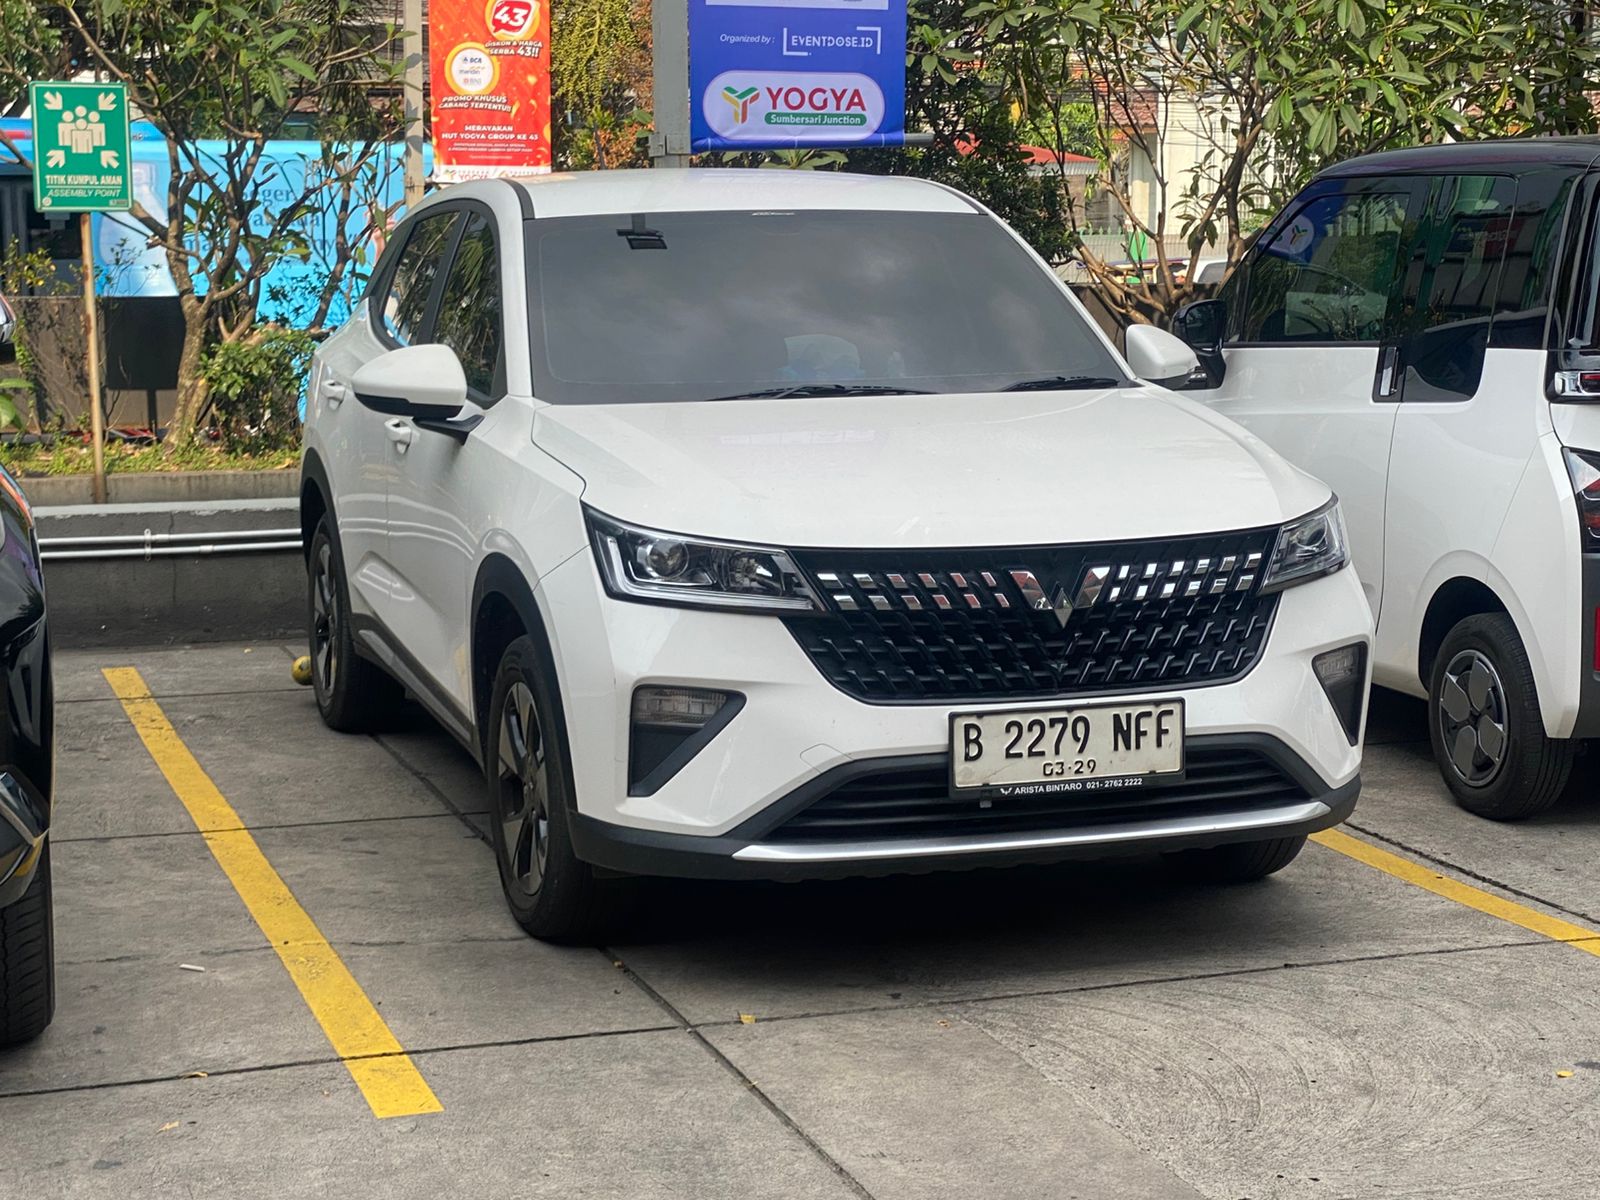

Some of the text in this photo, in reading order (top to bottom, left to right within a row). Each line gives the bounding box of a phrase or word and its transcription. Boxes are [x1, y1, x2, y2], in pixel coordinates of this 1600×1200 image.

[494, 6, 529, 27] 43
[485, 40, 511, 48] DISKON
[519, 40, 543, 48] HARGA
[720, 33, 760, 44] Organized
[791, 35, 873, 48] EVENTDOSE.ID
[517, 46, 539, 58] 43!!
[442, 95, 508, 104] PROMO KHUSUS
[766, 86, 867, 112] YOGYA
[770, 114, 861, 125] Sumbersari Junction
[464, 124, 514, 132] MERAYAKAN
[441, 132, 458, 140] HUT
[459, 132, 487, 140] YOGYA
[487, 133, 516, 141] GROUP
[516, 133, 528, 141] KE
[46, 174, 123, 186] TITIK KUMPUL AMAN
[47, 188, 122, 198] ASSEMBLY POINT
[963, 709, 1175, 762] B 2279 NFF
[1014, 785, 1046, 795] ARISTA
[1046, 782, 1083, 793] BINTARO
[1104, 779, 1123, 788] 2762
[1124, 777, 1143, 787] 2222
